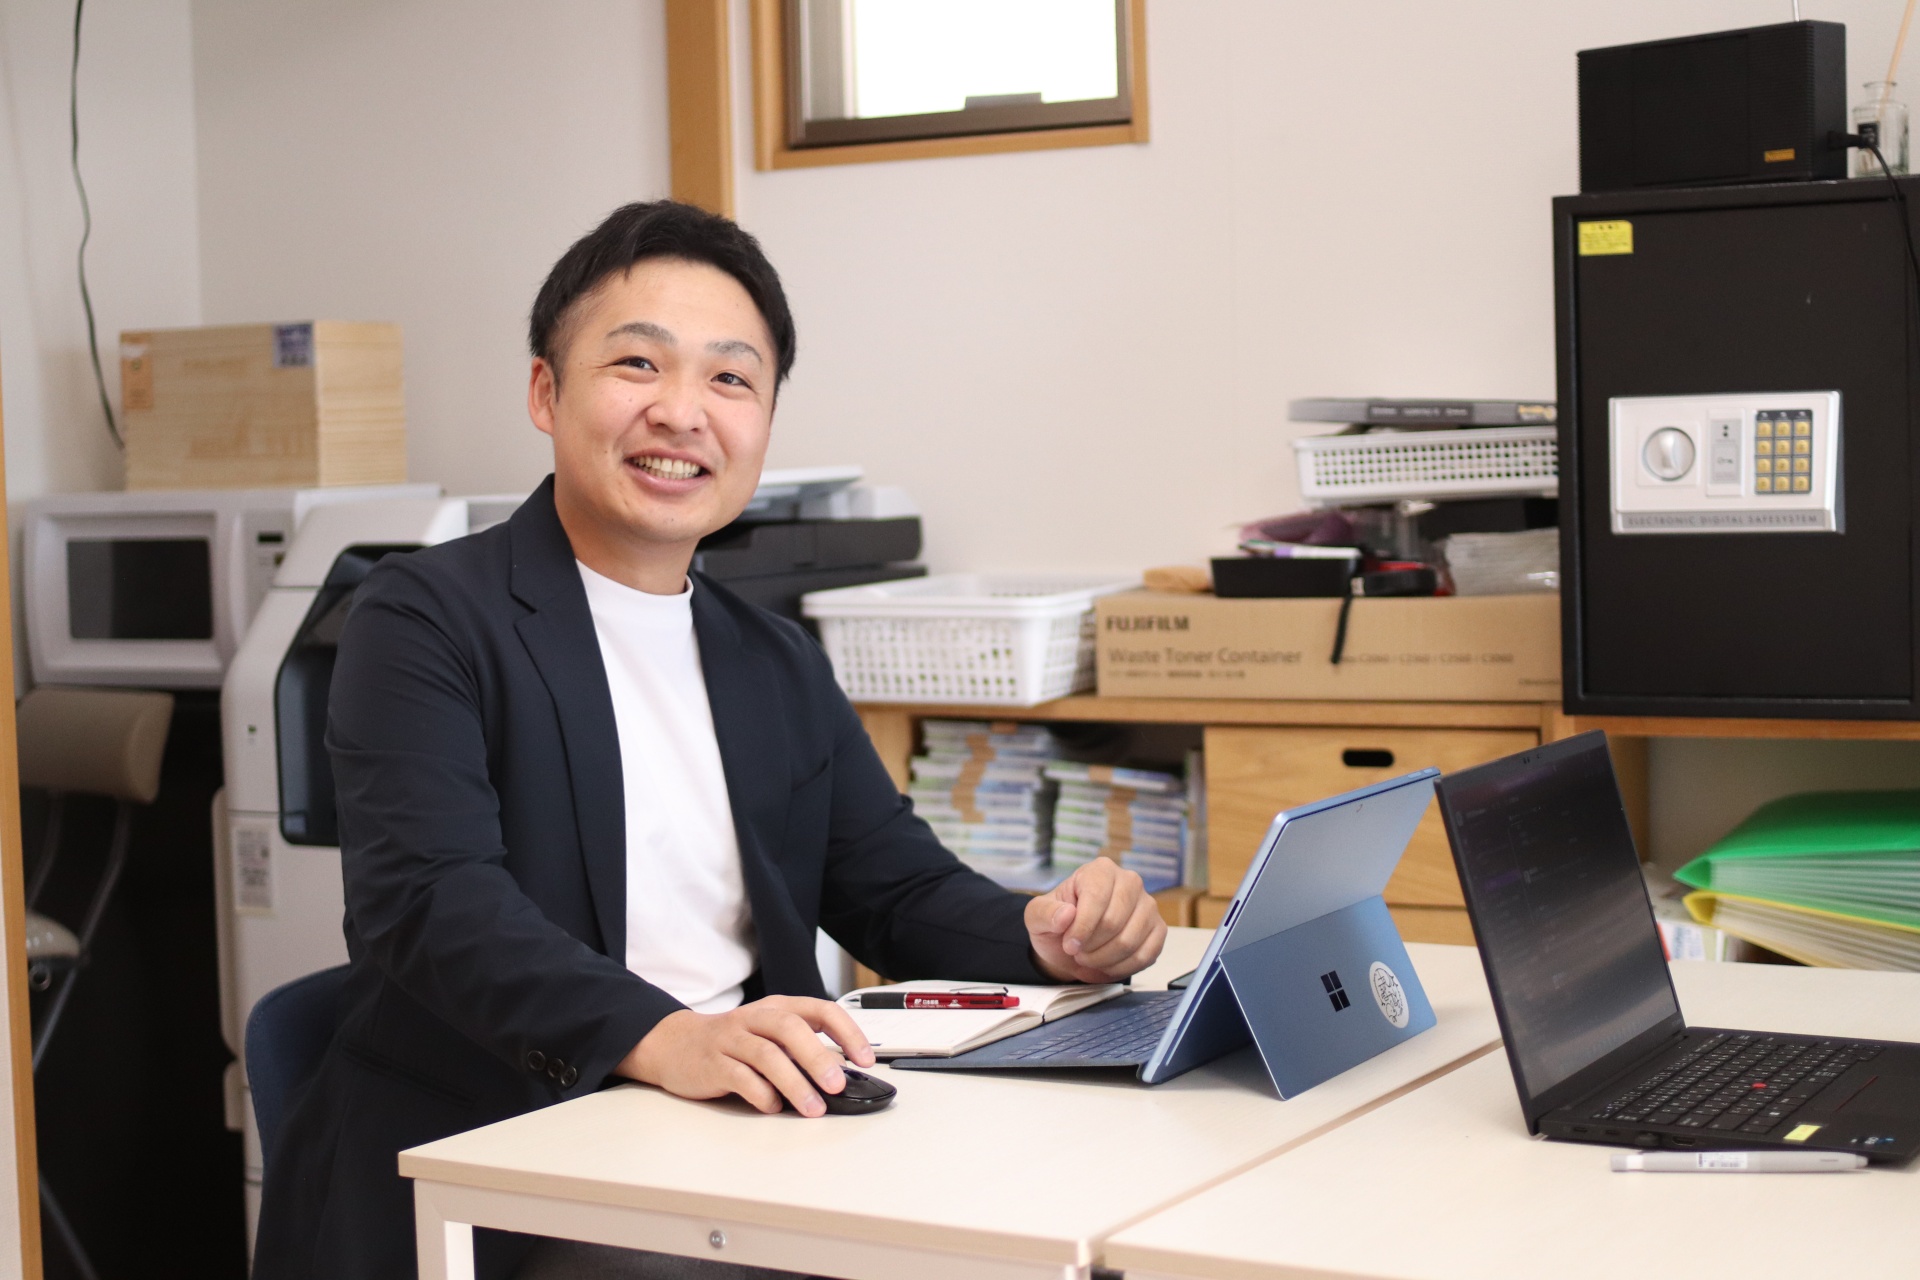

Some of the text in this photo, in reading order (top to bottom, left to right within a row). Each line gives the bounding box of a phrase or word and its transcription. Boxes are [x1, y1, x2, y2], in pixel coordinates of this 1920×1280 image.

[1628, 516, 1694, 526] ELECTRONIC
[1700, 515, 1744, 525] DIGITAL
[1106, 616, 1190, 632] FUJIFILM
[1108, 647, 1303, 664] Waste Toner Container
